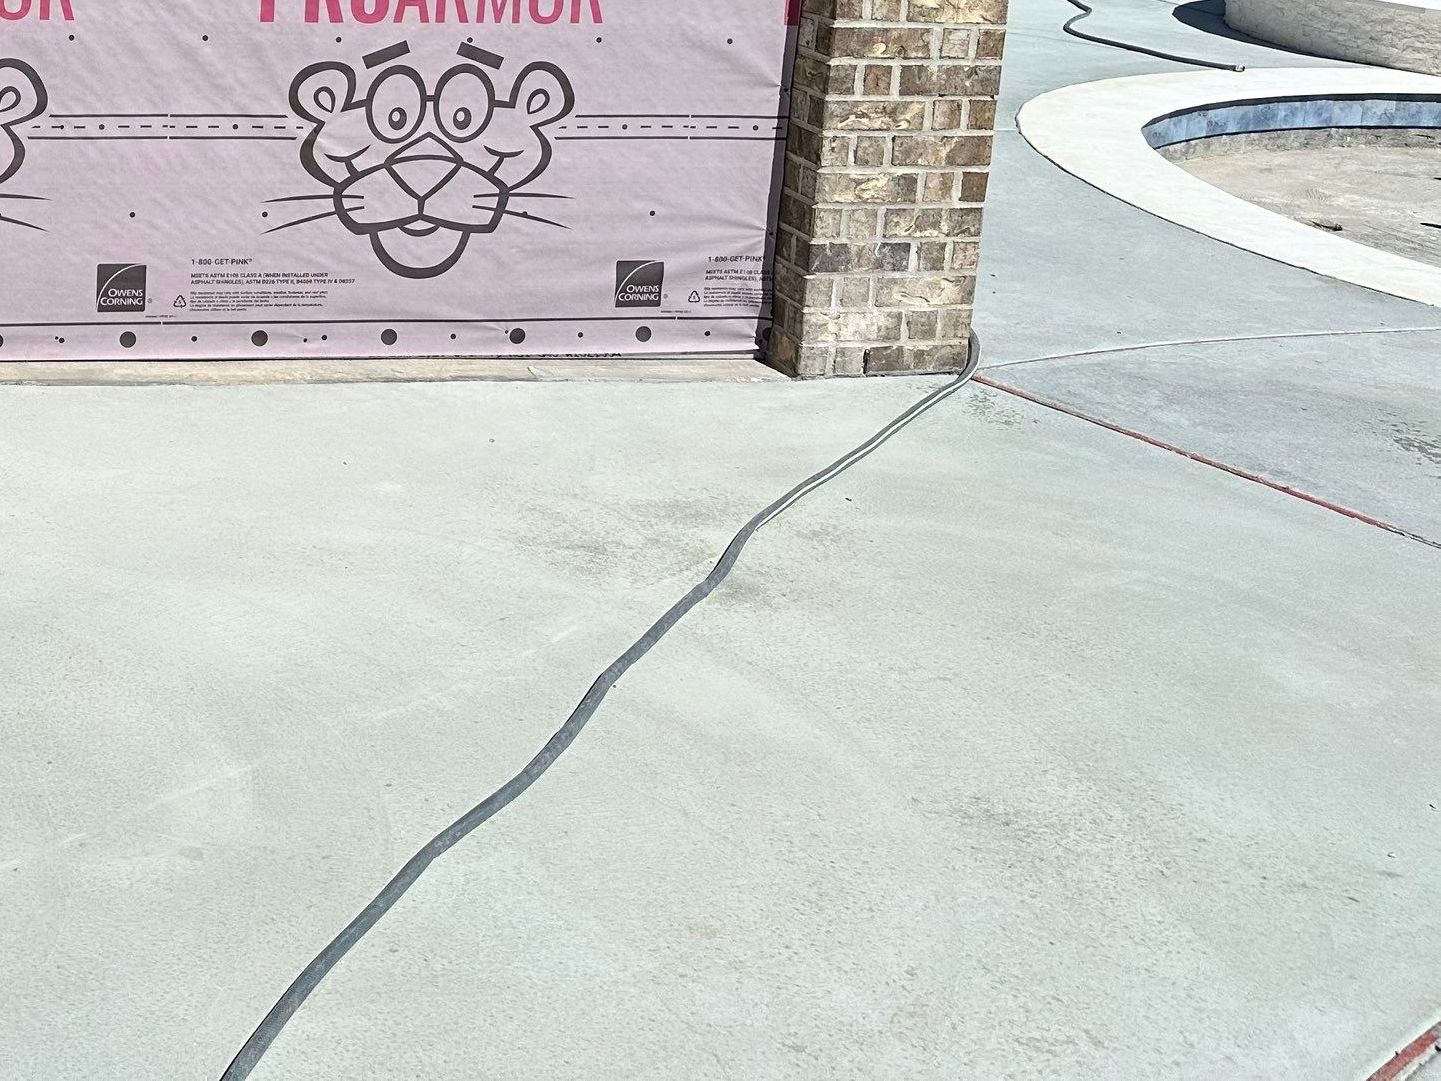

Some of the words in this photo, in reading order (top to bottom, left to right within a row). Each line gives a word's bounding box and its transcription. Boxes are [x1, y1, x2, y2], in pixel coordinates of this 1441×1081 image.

[108, 288, 143, 297] OWENS
[627, 284, 659, 293] OWENS
[100, 297, 143, 306] CORNING
[618, 293, 659, 301] CORNING
